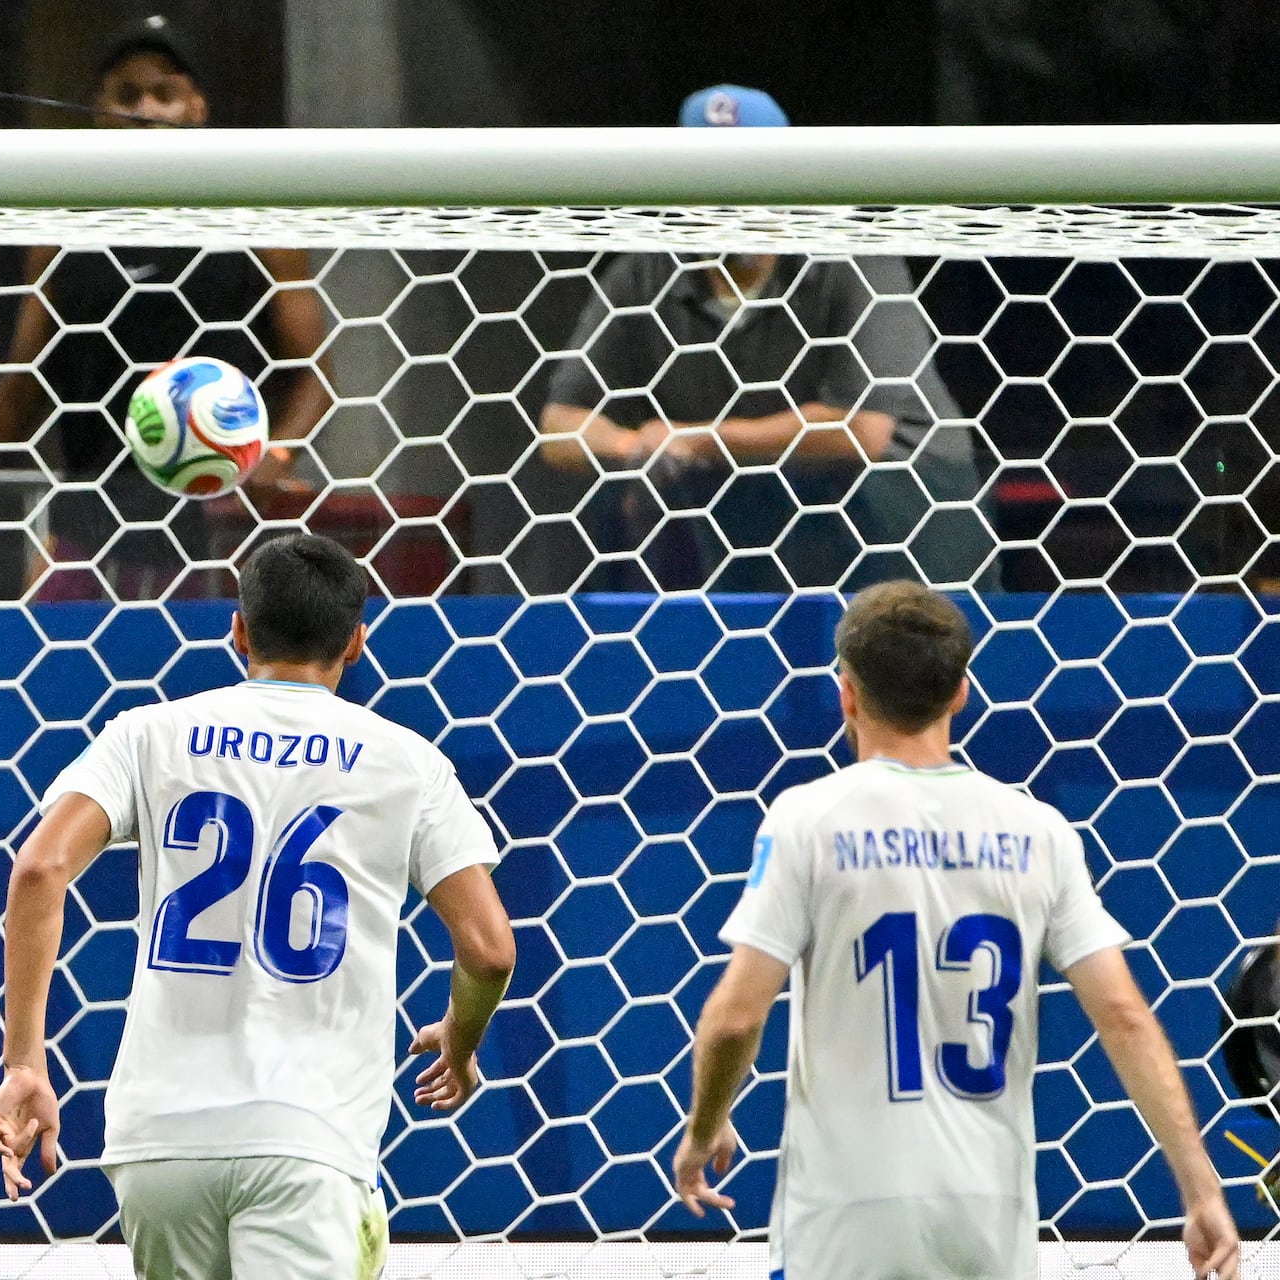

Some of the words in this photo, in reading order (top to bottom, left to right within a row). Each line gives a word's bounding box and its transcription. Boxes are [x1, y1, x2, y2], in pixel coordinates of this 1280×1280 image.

[187, 725, 364, 773] UROZOV
[147, 791, 350, 984] 26
[833, 827, 1032, 874] NASRULLAEV
[853, 911, 1023, 1103] 13
